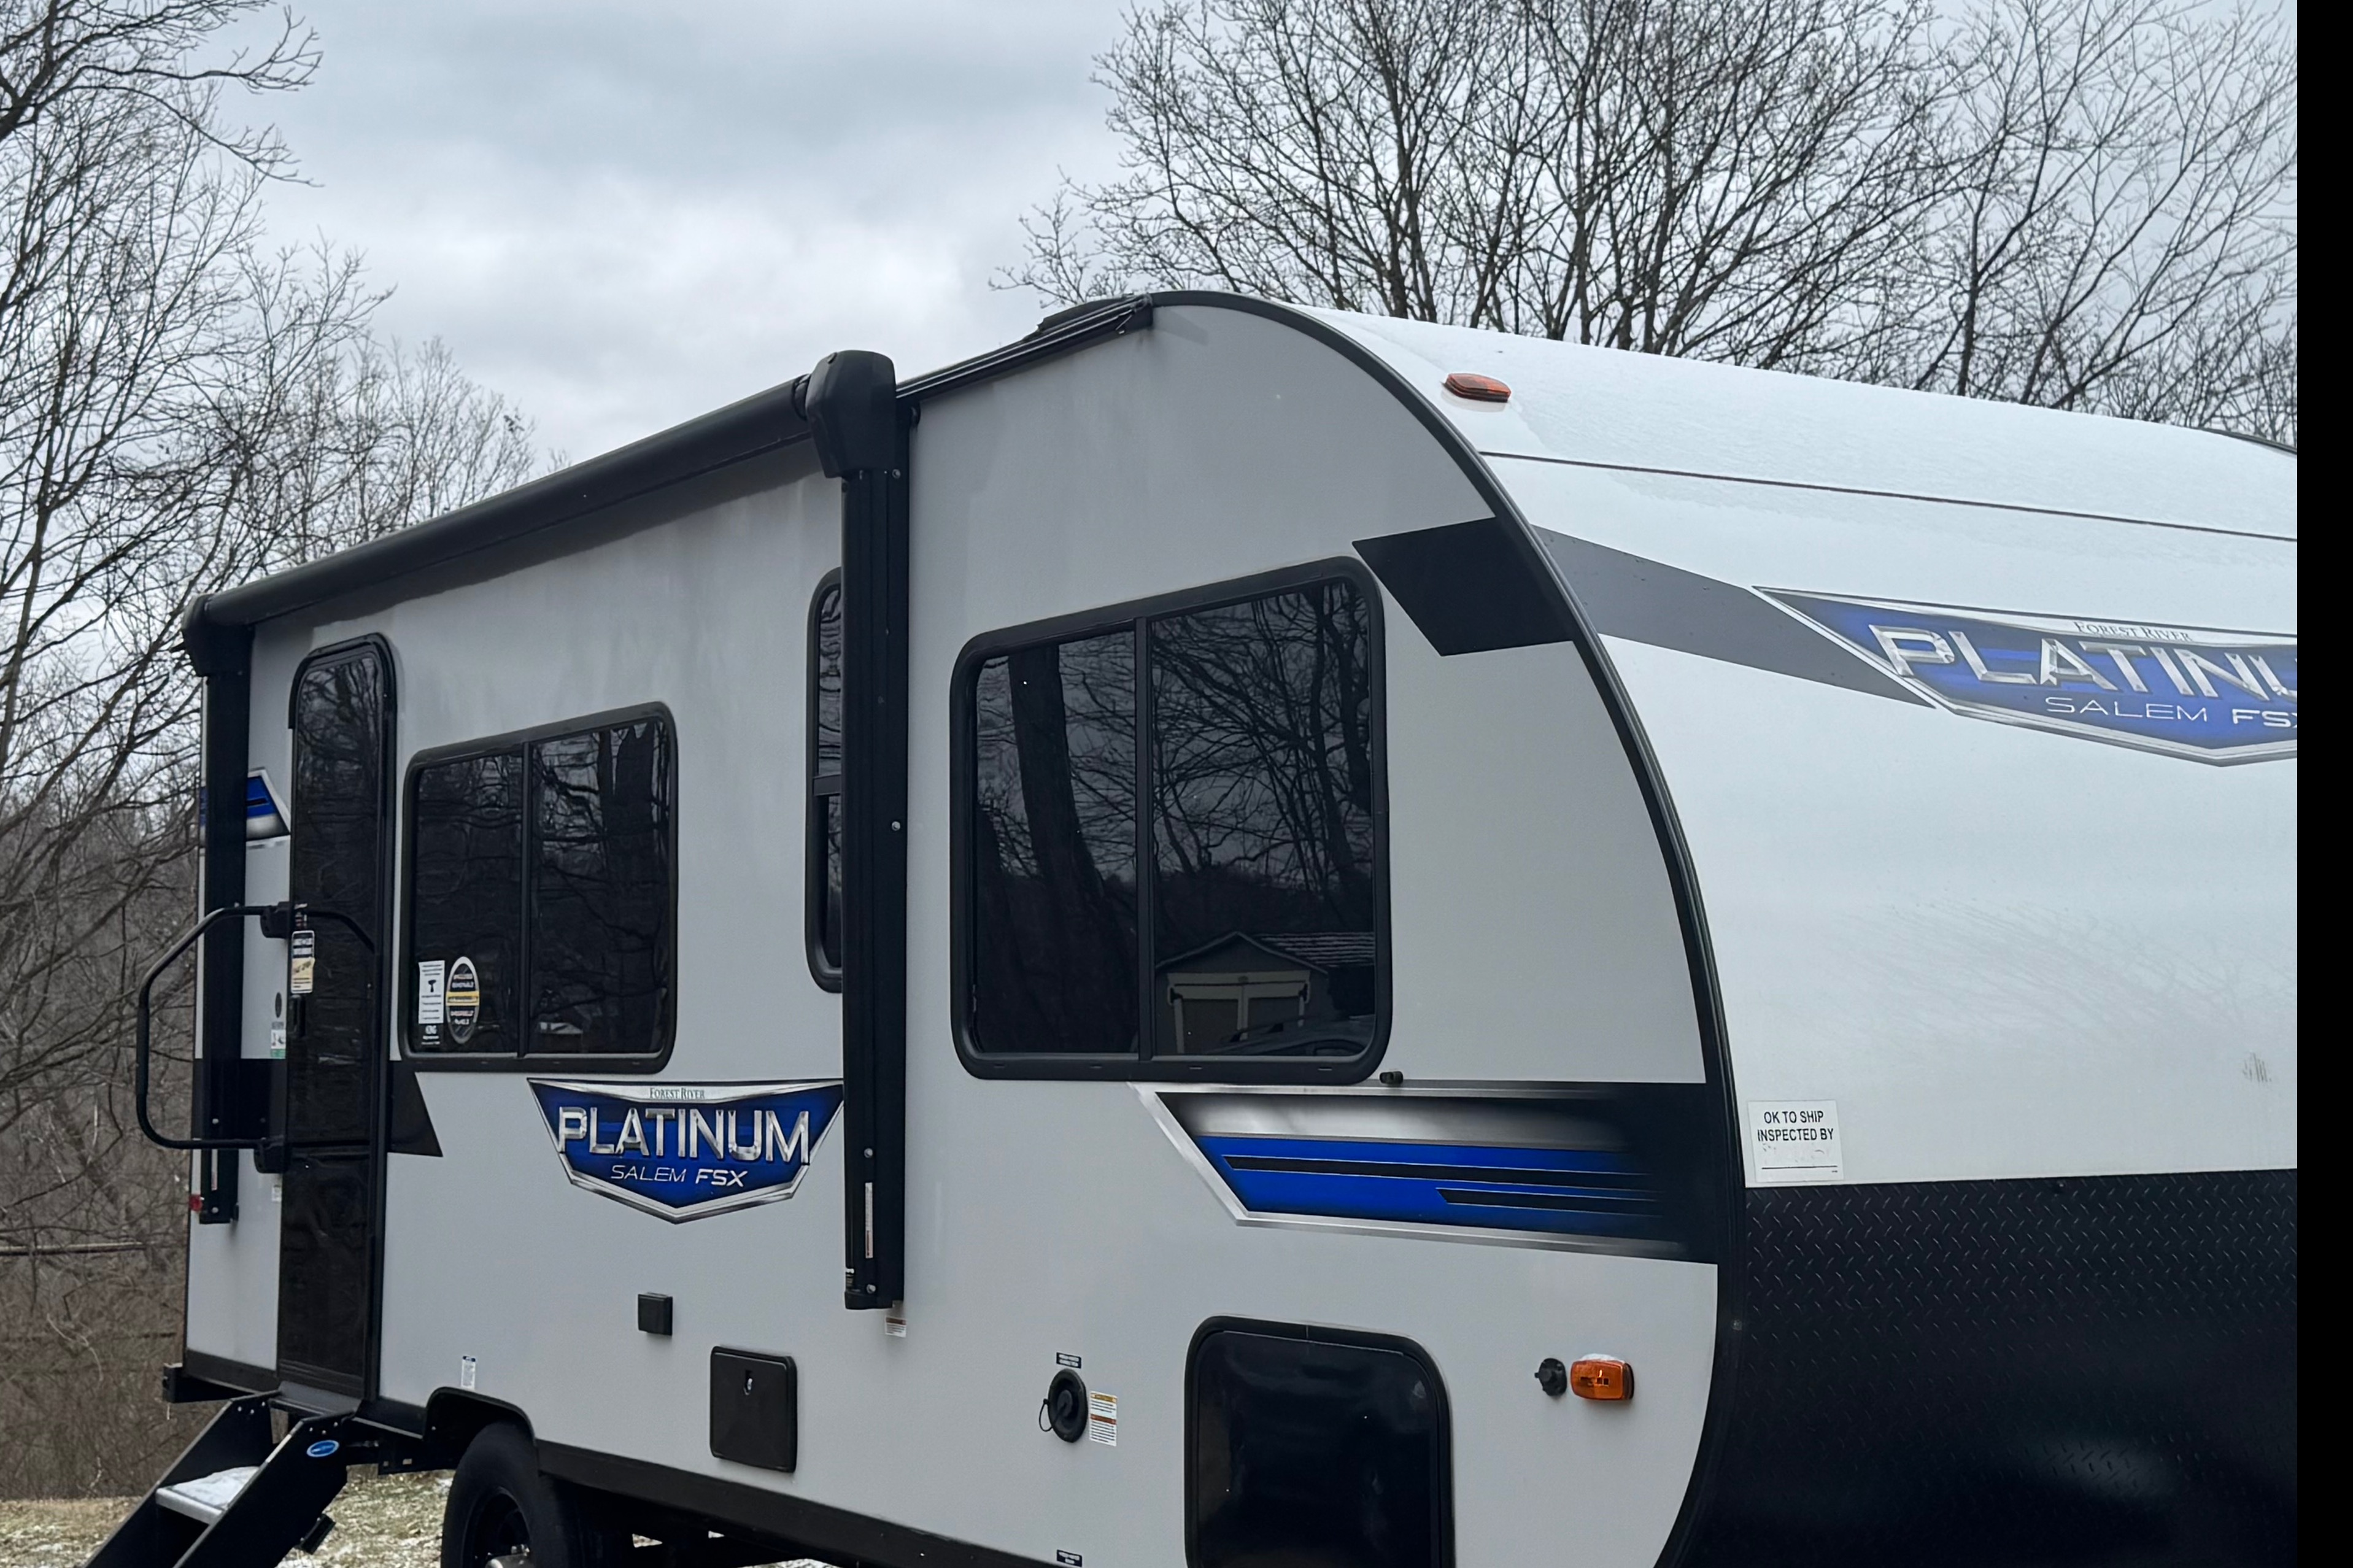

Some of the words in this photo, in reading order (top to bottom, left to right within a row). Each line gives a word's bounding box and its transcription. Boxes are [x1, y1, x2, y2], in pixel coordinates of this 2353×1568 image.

[2074, 621, 2138, 637] FOREST
[2141, 626, 2193, 643] RIVER
[2046, 697, 2207, 722] SALEM
[2232, 708, 2297, 729] FS
[1764, 1111, 1780, 1124] OK
[1782, 1111, 1797, 1124] TO
[1800, 1110, 1823, 1123] SHIP
[558, 1106, 810, 1164] PLATINUM
[1757, 1128, 1817, 1141] INSPECTED
[1820, 1128, 1834, 1140] BY
[611, 1165, 687, 1183] SALEM
[695, 1168, 748, 1187] FSX
